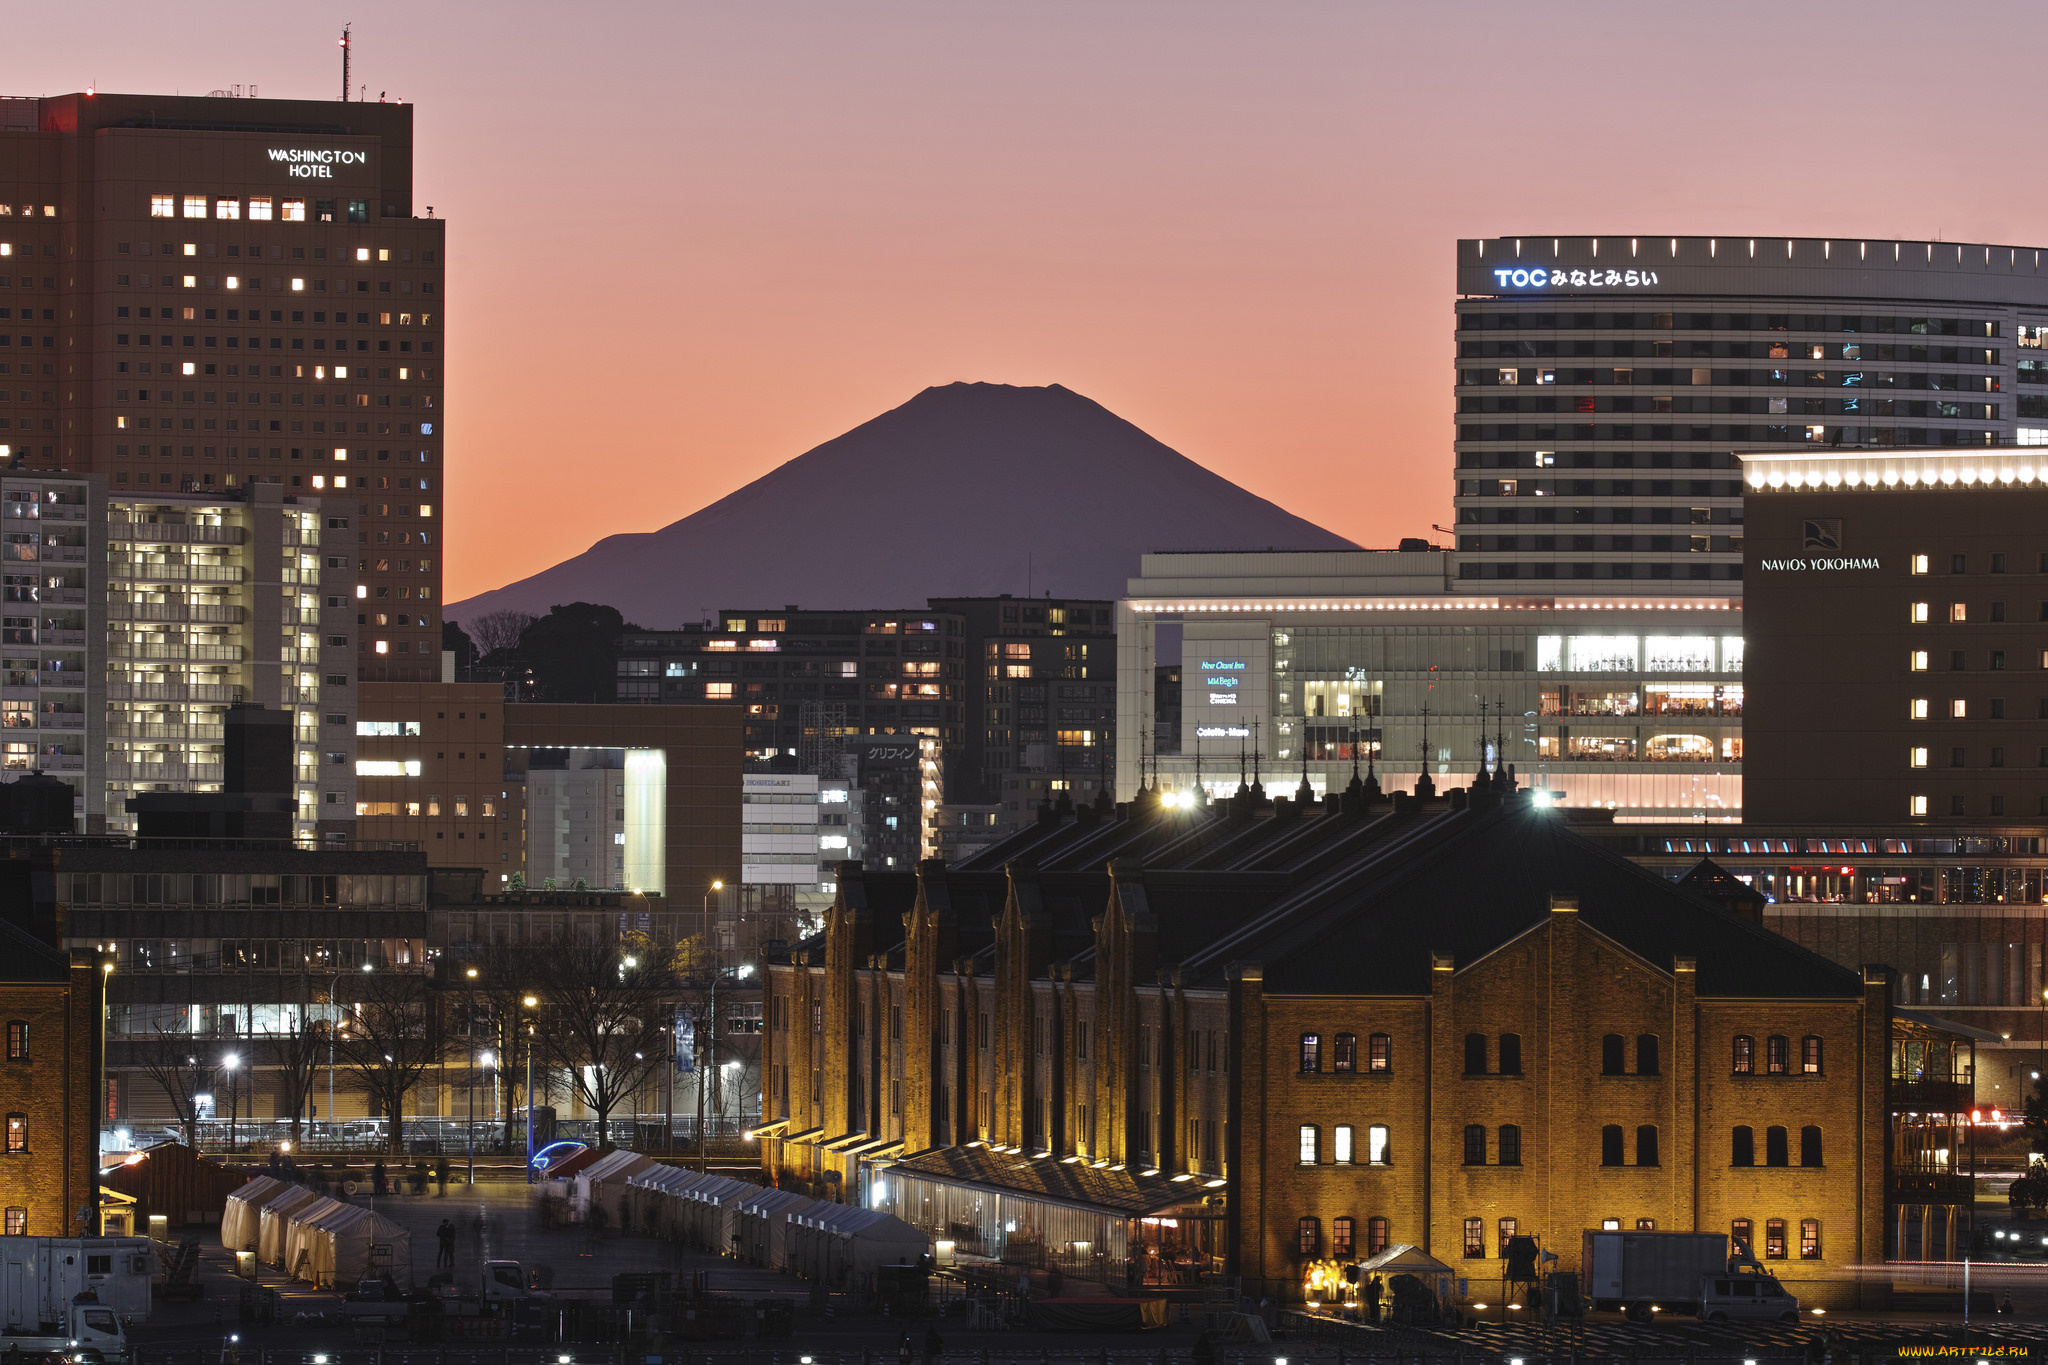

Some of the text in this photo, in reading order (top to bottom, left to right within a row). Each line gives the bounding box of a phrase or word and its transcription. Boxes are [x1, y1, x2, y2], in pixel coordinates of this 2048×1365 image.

[268, 149, 365, 164] WASHINGTON
[289, 164, 333, 178] HOTEL
[1494, 269, 1658, 287] TOC みなとみらい
[1761, 558, 1880, 571] NAVIOS YOKOHAMA
[868, 746, 915, 760] グリフィン
